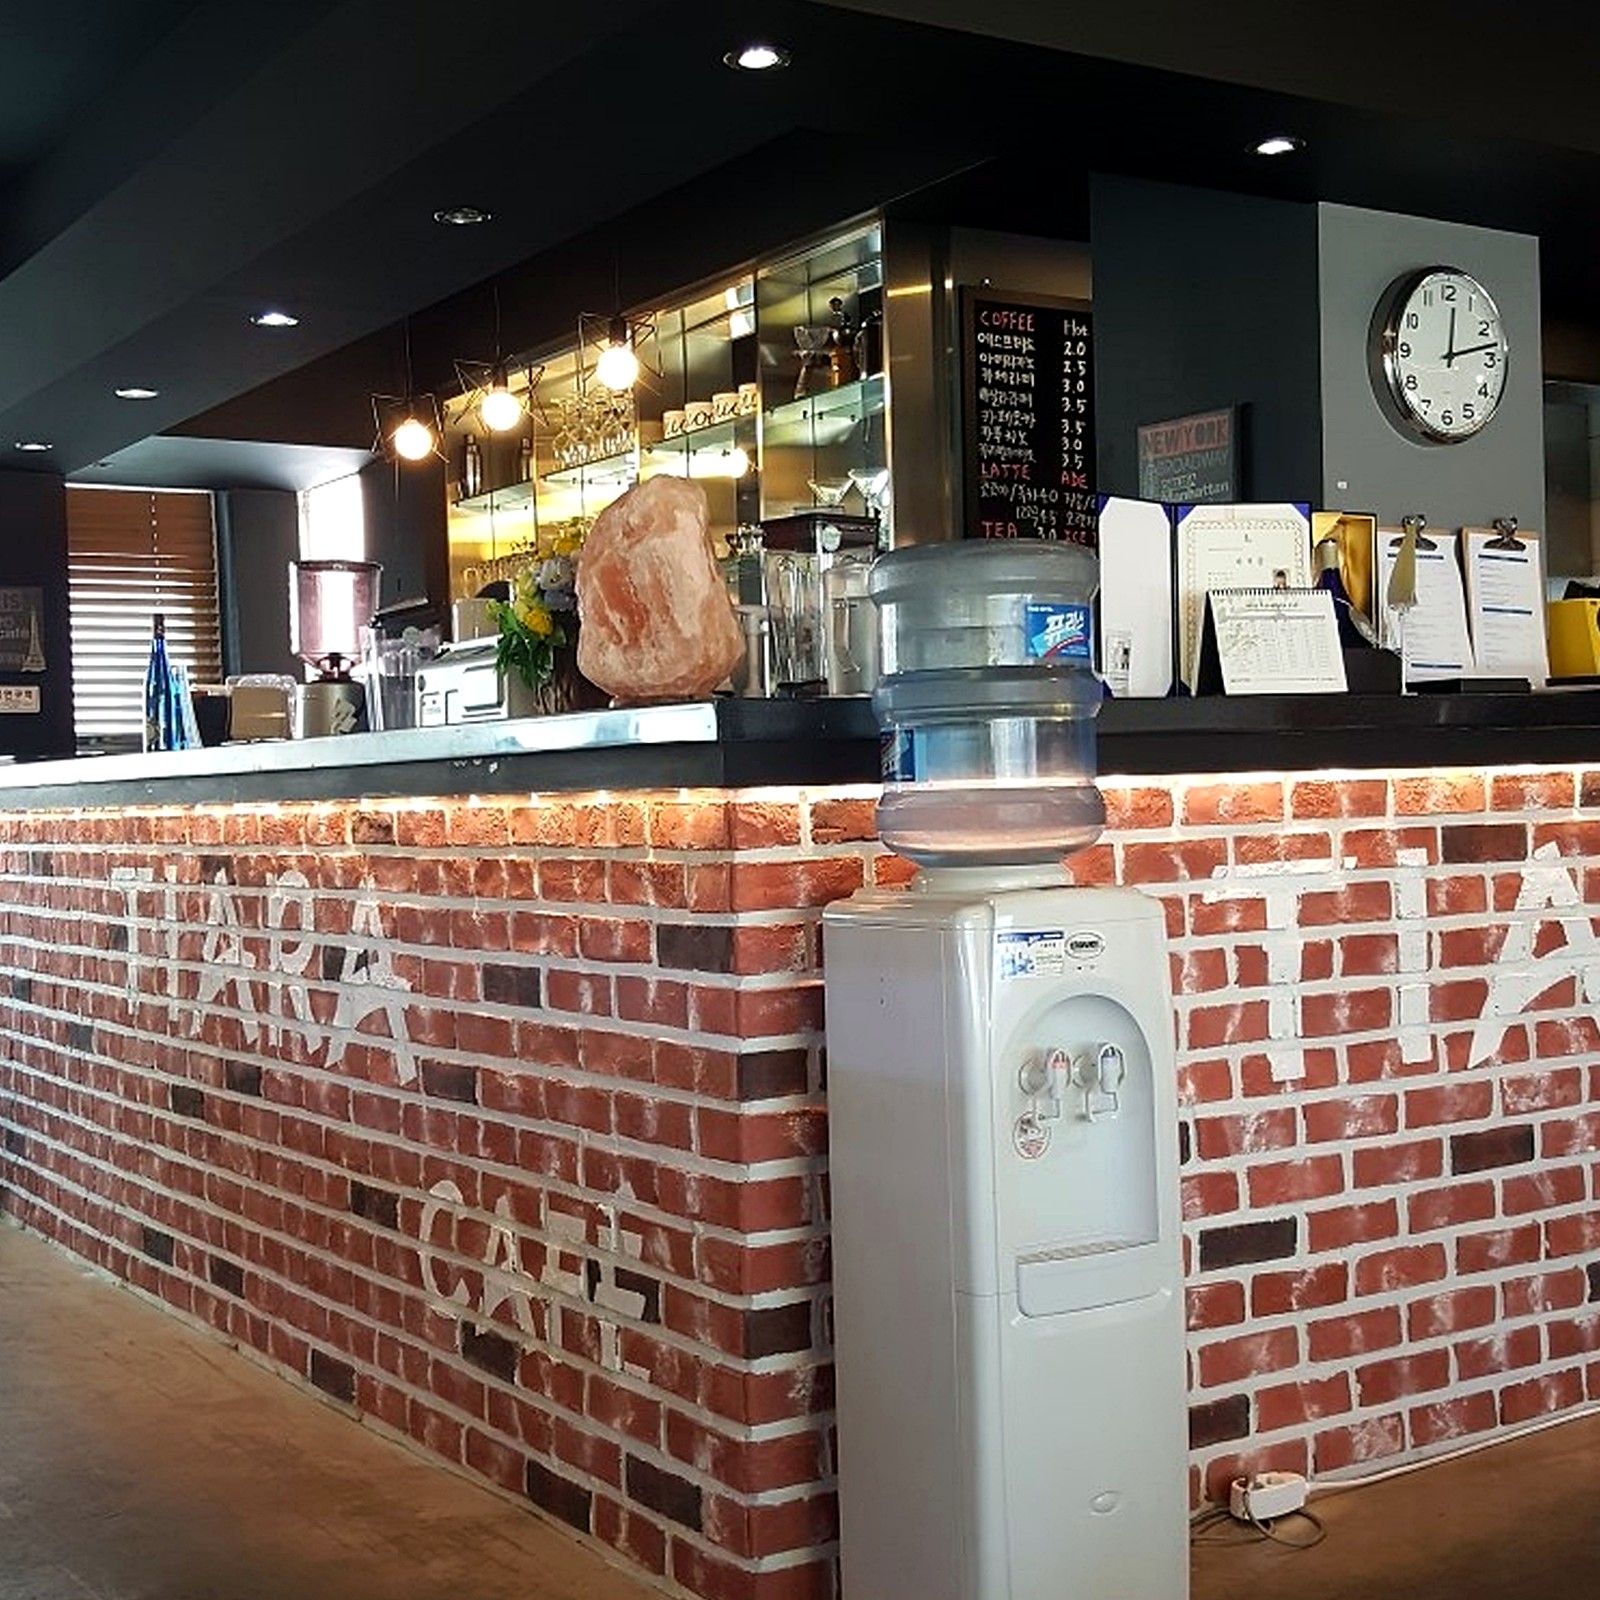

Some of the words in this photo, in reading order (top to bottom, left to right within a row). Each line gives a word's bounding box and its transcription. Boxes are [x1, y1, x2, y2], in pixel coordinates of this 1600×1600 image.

[1423, 289, 1434, 307] 11
[1440, 284, 1458, 303] 12
[980, 310, 1035, 332] COFFEE
[1064, 318, 1090, 338] Hot
[1405, 312, 1420, 330] 10
[1477, 320, 1491, 338] 2
[1063, 340, 1087, 357] 2.0
[1399, 342, 1412, 359] 9
[1484, 351, 1497, 369] 3
[1061, 377, 1085, 395] 3.0
[1405, 375, 1419, 391] 8
[1477, 382, 1490, 399] 4
[1061, 396, 1088, 415] 3.5
[1420, 399, 1432, 416] 7
[1462, 403, 1475, 420] 5
[1440, 409, 1454, 426] 6
[1061, 418, 1087, 436] 3.5
[1061, 436, 1083, 452] 3.0
[980, 462, 1031, 481] LATTE
[1061, 470, 1089, 490] ADE
[981, 521, 1018, 541] TEA
[110, 866, 420, 1087] TIARA
